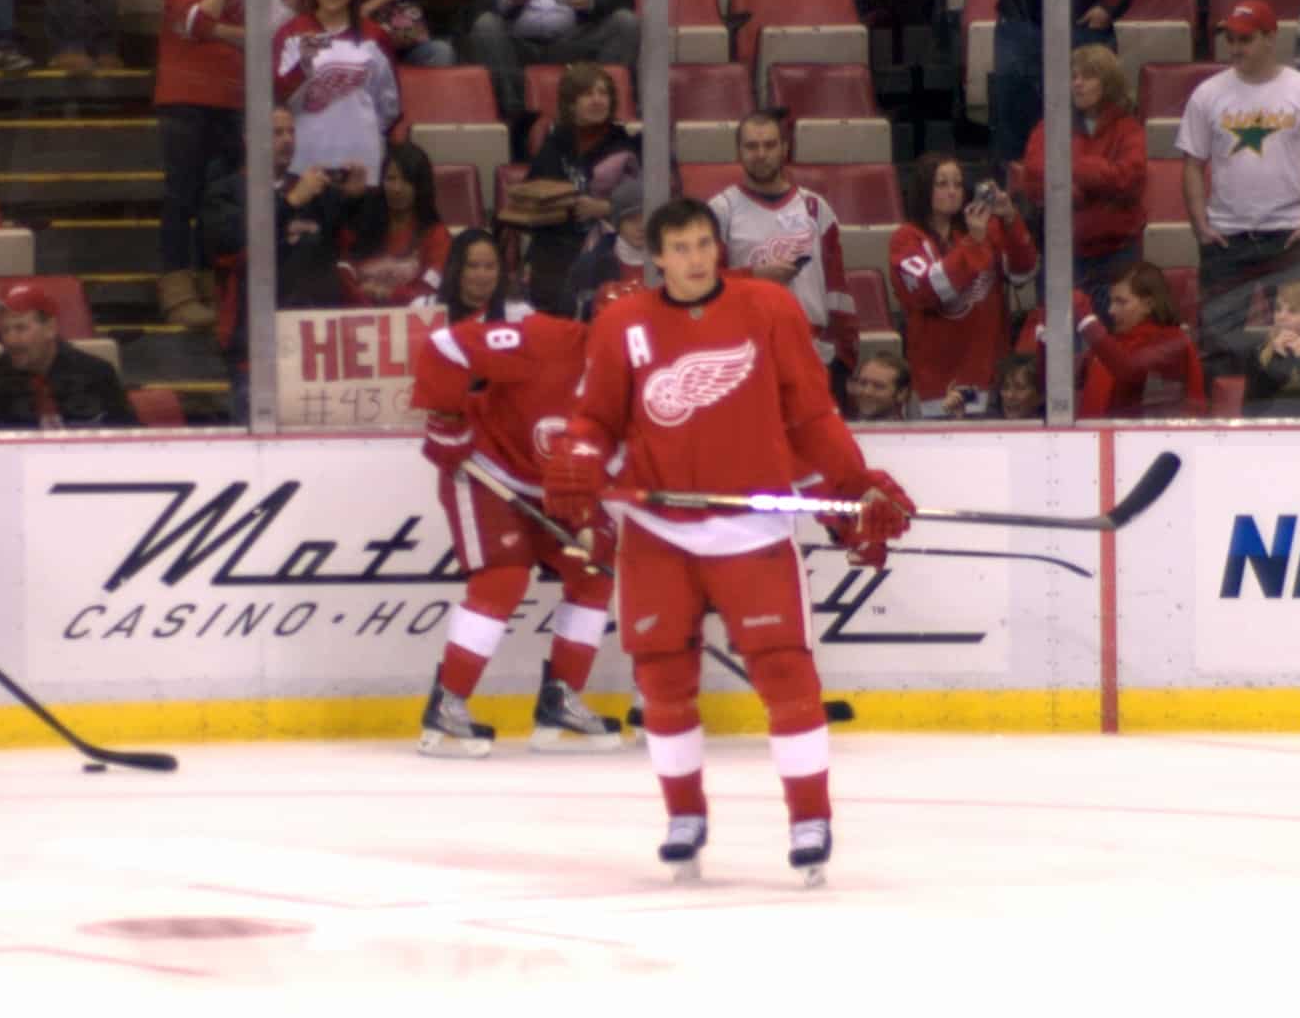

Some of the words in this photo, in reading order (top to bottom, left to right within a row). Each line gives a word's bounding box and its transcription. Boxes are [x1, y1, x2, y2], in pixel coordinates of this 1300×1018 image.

[625, 324, 652, 369] A
[301, 387, 383, 425] #43
[62, 604, 317, 639] CASINO
[355, 600, 555, 635] HOEL
